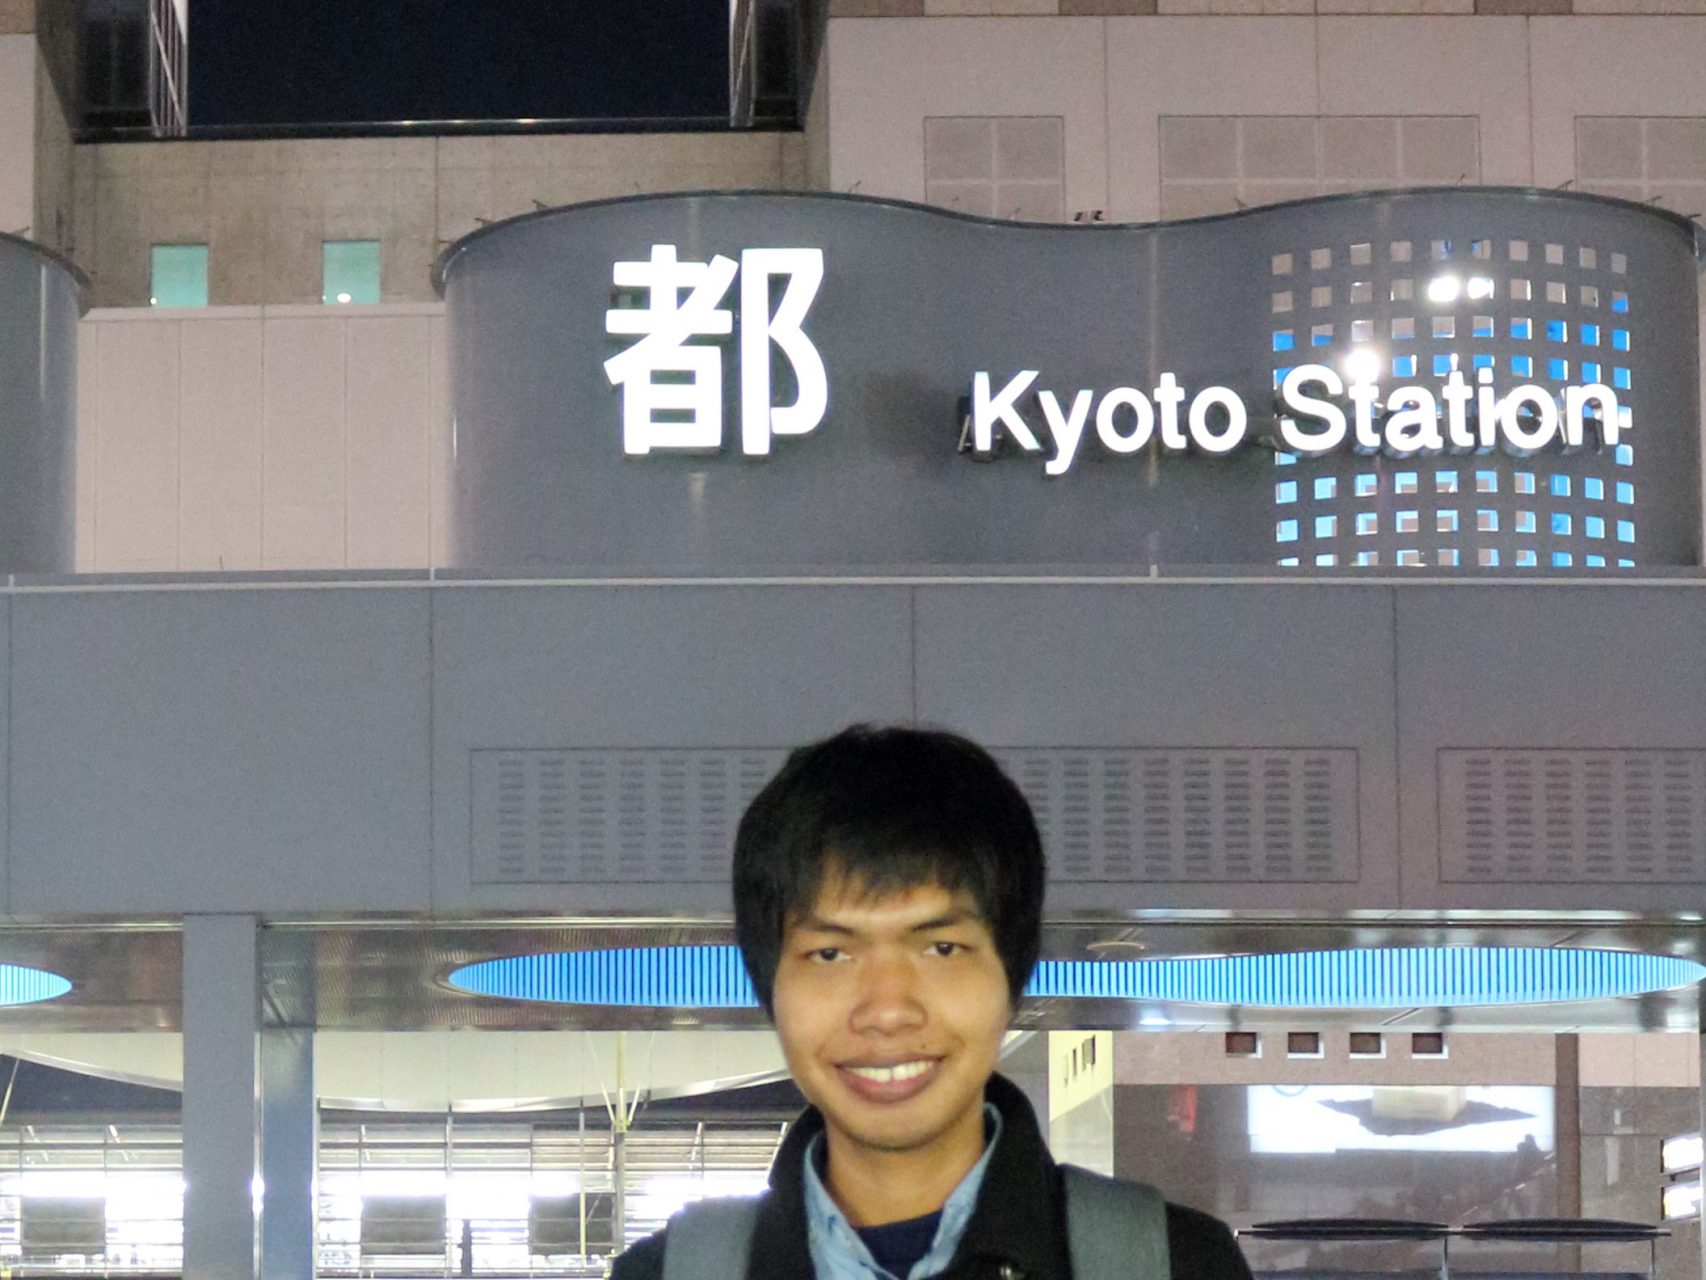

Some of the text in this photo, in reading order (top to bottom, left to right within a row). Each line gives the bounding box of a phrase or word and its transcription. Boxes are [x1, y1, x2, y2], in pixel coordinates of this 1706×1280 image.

[605, 244, 829, 456] 都
[972, 363, 1620, 476] Kyoto Station
